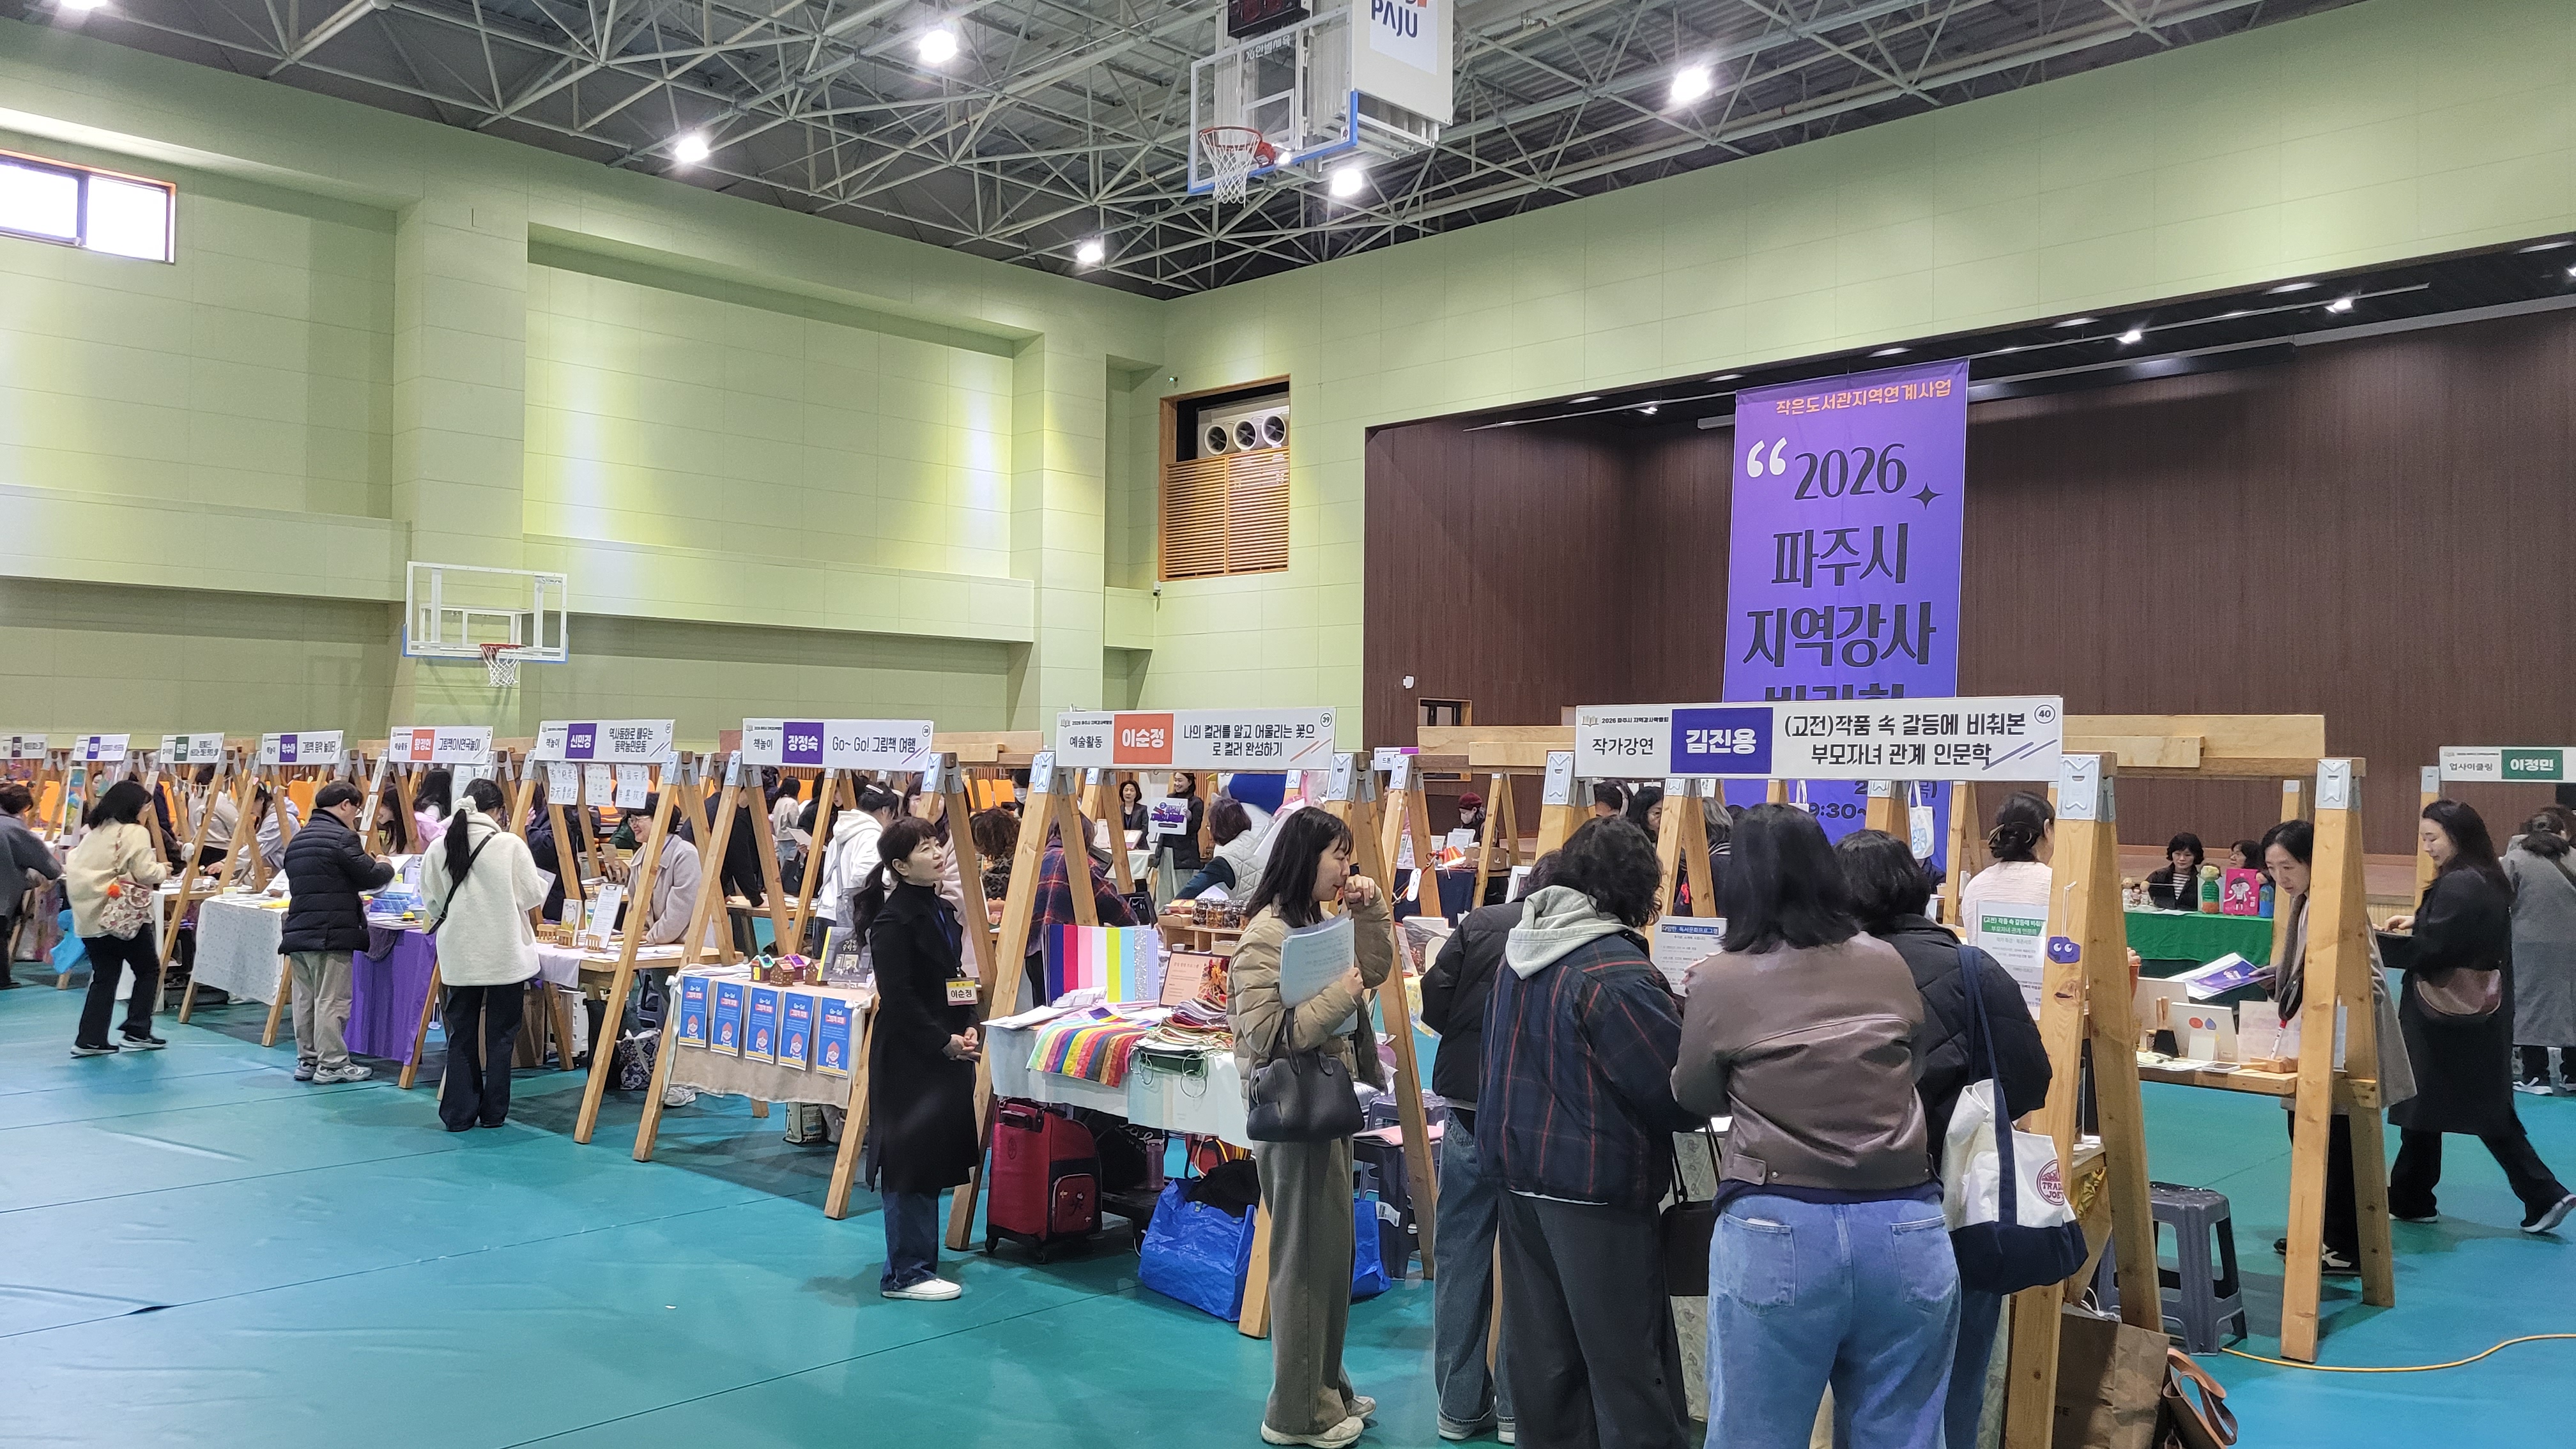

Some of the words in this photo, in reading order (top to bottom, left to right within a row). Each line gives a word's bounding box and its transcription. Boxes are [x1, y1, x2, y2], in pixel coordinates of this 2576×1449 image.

[1371, 0, 1418, 38] PAJU
[1776, 379, 1951, 415] 작은도서관지역연계사업
[1794, 443, 1907, 500] 2026
[1771, 523, 1909, 588] 파주시
[1744, 601, 1936, 668] 지역강사
[2039, 710, 2051, 718] 40
[1184, 724, 1201, 739] 나의
[1204, 724, 1230, 739] 컬러를
[1234, 724, 1251, 739] 알고
[1255, 724, 1292, 739] 어울리는
[1296, 724, 1315, 739] 꽃으
[1784, 714, 1870, 737] (고전)작품
[1878, 714, 1896, 736] 속
[1902, 713, 1958, 736] 갈등에
[1966, 713, 2026, 735] 비춰본
[637, 728, 654, 740] 우는
[1122, 729, 1165, 748] 이순정
[1685, 728, 1757, 755] 김진용
[615, 740, 647, 753] 동학농민운동
[753, 738, 773, 751] 책놀이
[788, 735, 818, 751] 장정숙
[832, 736, 851, 751] Go~
[854, 736, 870, 752] Go!
[872, 736, 896, 753] 그림책
[900, 737, 916, 753] 여행
[1069, 736, 1103, 749] 예술활동
[1212, 742, 1222, 756] 로
[1225, 742, 1243, 756] 컬러
[1245, 742, 1283, 757] 완성하기
[1592, 737, 1654, 756] 작가강연
[1811, 742, 1882, 766] 부모자녀
[1889, 742, 1926, 765] 관계
[1933, 742, 1992, 765] 인문학
[2449, 763, 2493, 772] 업사이클링
[2510, 758, 2554, 772] 이정민
[951, 990, 972, 998] 이순정
[2042, 1182, 2062, 1190] TRAD
